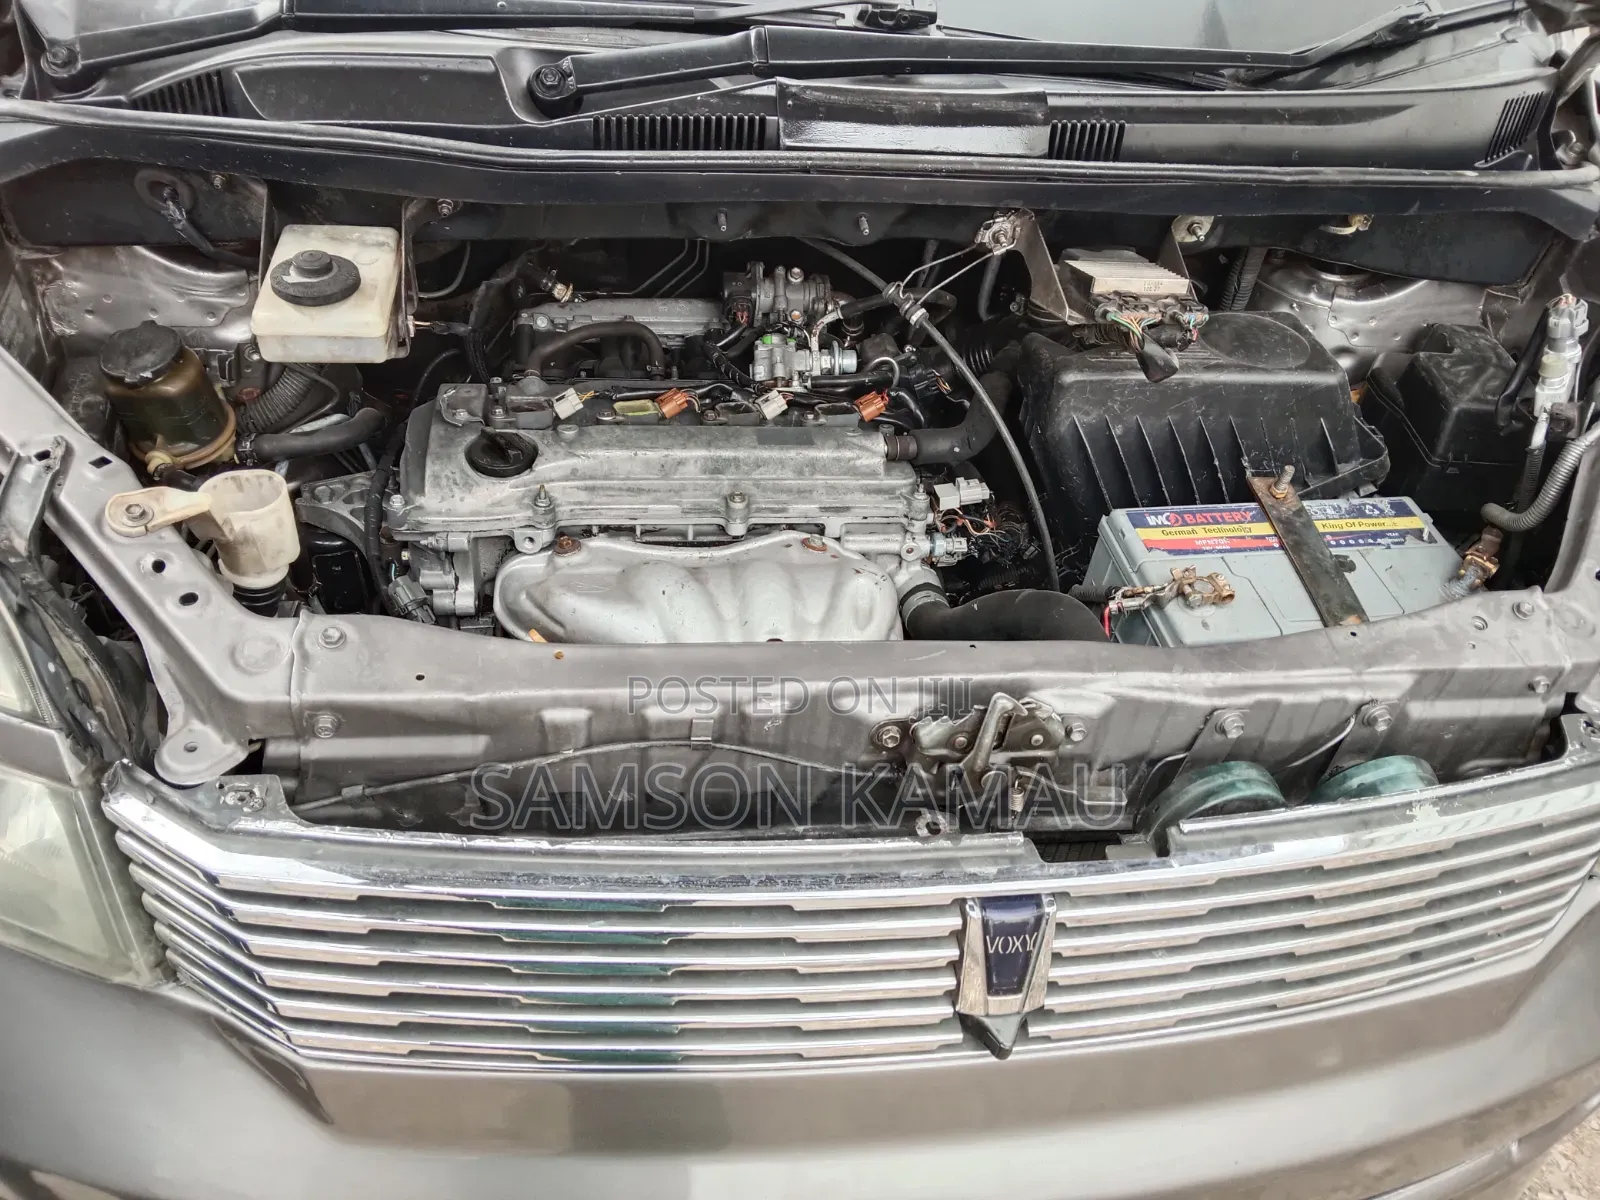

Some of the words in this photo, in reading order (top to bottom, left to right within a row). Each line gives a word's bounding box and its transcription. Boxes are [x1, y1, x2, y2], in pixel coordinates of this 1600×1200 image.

[1183, 511, 1253, 525] BATTERY
[1161, 528, 1198, 537] German
[1203, 525, 1252, 535] Technology
[1322, 521, 1344, 530] King
[986, 932, 1038, 954] VOXY
